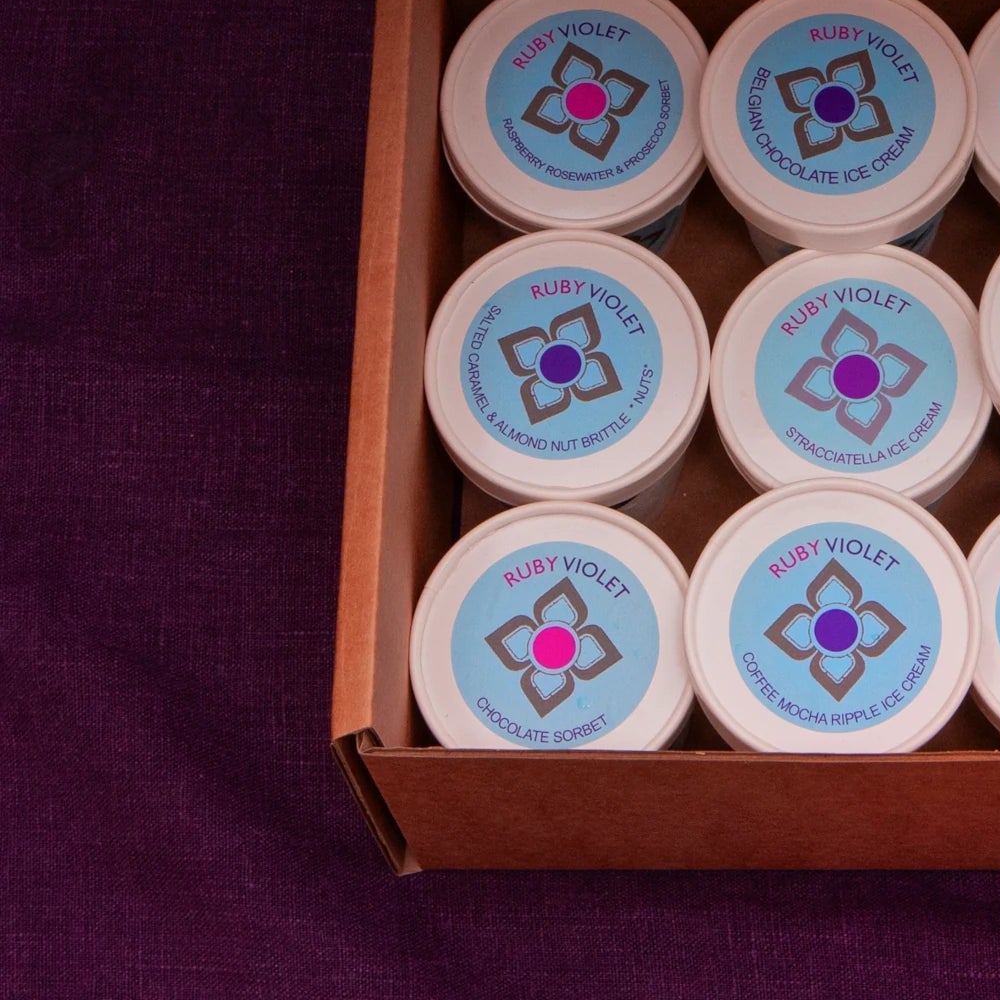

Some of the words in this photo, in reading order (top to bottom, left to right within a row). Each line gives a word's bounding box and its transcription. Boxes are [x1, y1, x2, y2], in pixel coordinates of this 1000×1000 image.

[512, 30, 556, 70] RUBY
[558, 22, 630, 42] VIOLET
[809, 26, 864, 42] RUBY
[866, 32, 919, 83] VIOLET
[748, 67, 771, 132] BELGIAN
[503, 117, 547, 170] RASPBERRY
[546, 166, 614, 182] ROSEWATER
[615, 165, 623, 173] &
[623, 121, 667, 170] PROSECCO
[658, 79, 671, 120] SORBET
[872, 126, 915, 172] CREAM
[756, 133, 839, 184] CHOCOLATE
[844, 165, 871, 183] ICE
[470, 305, 501, 350] SALTED
[530, 280, 586, 299] RUBY
[590, 284, 645, 336] VIOLET
[780, 293, 829, 336] RUBY
[833, 288, 912, 315] VIOLET
[468, 353, 487, 413] CARAMEL
[486, 411, 496, 423] &
[493, 420, 547, 451] ALMOND
[582, 412, 631, 448] BRITTLE
[785, 426, 887, 465] STRACCIATELLA
[887, 440, 910, 458] ICE
[908, 402, 942, 443] CREAM
[550, 439, 578, 452] NUT
[503, 556, 558, 587] RUBY
[563, 556, 630, 599] VIOLET
[768, 539, 821, 579] RUBY
[824, 538, 900, 572] VIOLET
[742, 652, 780, 703] COFFEE
[777, 698, 828, 725] MOCHA
[831, 704, 880, 725] RIPPLE
[882, 690, 905, 711] ICE
[901, 644, 931, 691] CREAM
[477, 697, 549, 743] CHOCOLATE
[553, 714, 608, 743] SORBET
